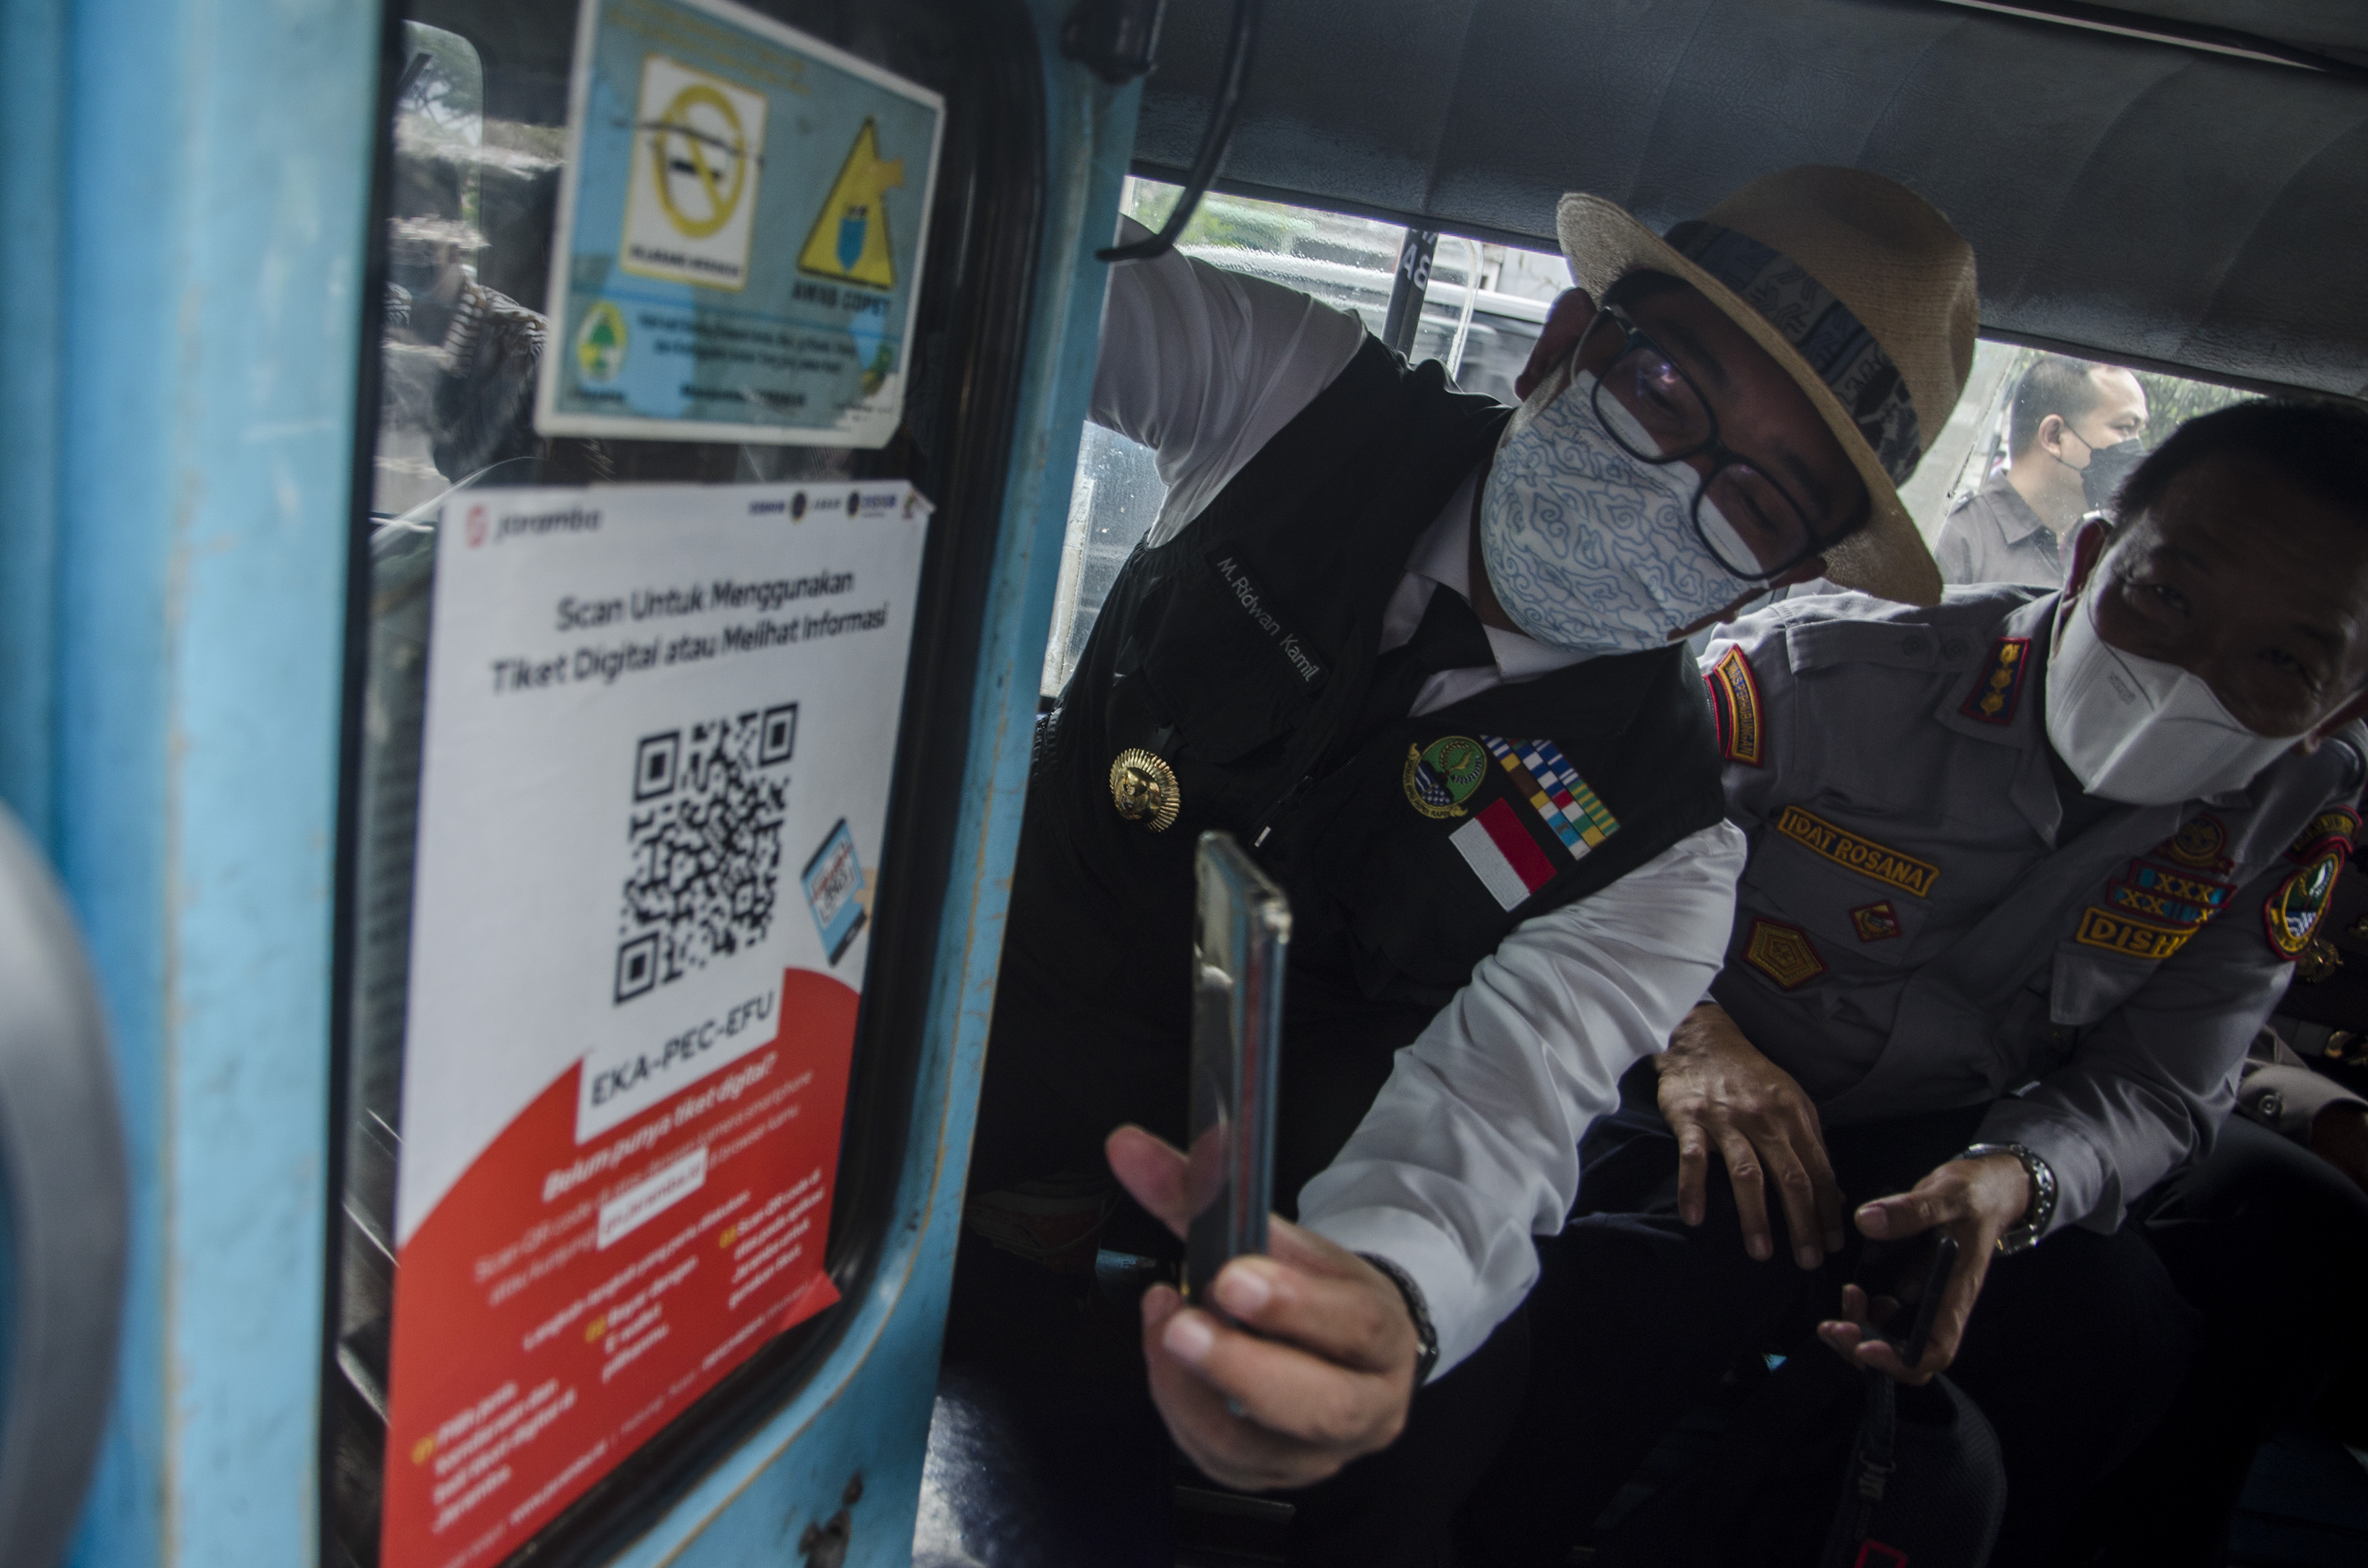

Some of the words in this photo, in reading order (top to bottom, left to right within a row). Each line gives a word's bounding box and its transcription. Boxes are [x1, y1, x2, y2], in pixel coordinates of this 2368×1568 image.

[555, 594, 623, 631] Scan
[630, 580, 703, 621] Untuk
[710, 569, 854, 611] Menggunakan
[1217, 557, 1237, 582] M.
[1231, 577, 1280, 636] Ridwan
[1279, 633, 1320, 682] Kamil
[491, 655, 567, 693] Tiket
[574, 639, 658, 684] Digital
[664, 631, 715, 661] atau
[722, 616, 799, 653] Melihat
[803, 602, 889, 639] Informasi
[1736, 682, 1755, 756] PERHUBUNGAN
[1787, 813, 1836, 851] IDAT
[1835, 838, 1923, 890] ROSANA
[591, 990, 774, 1107] EKA-PEC-EFU
[543, 1148, 611, 1203] Belum
[610, 1116, 671, 1170] punya
[674, 1087, 715, 1127] tiket
